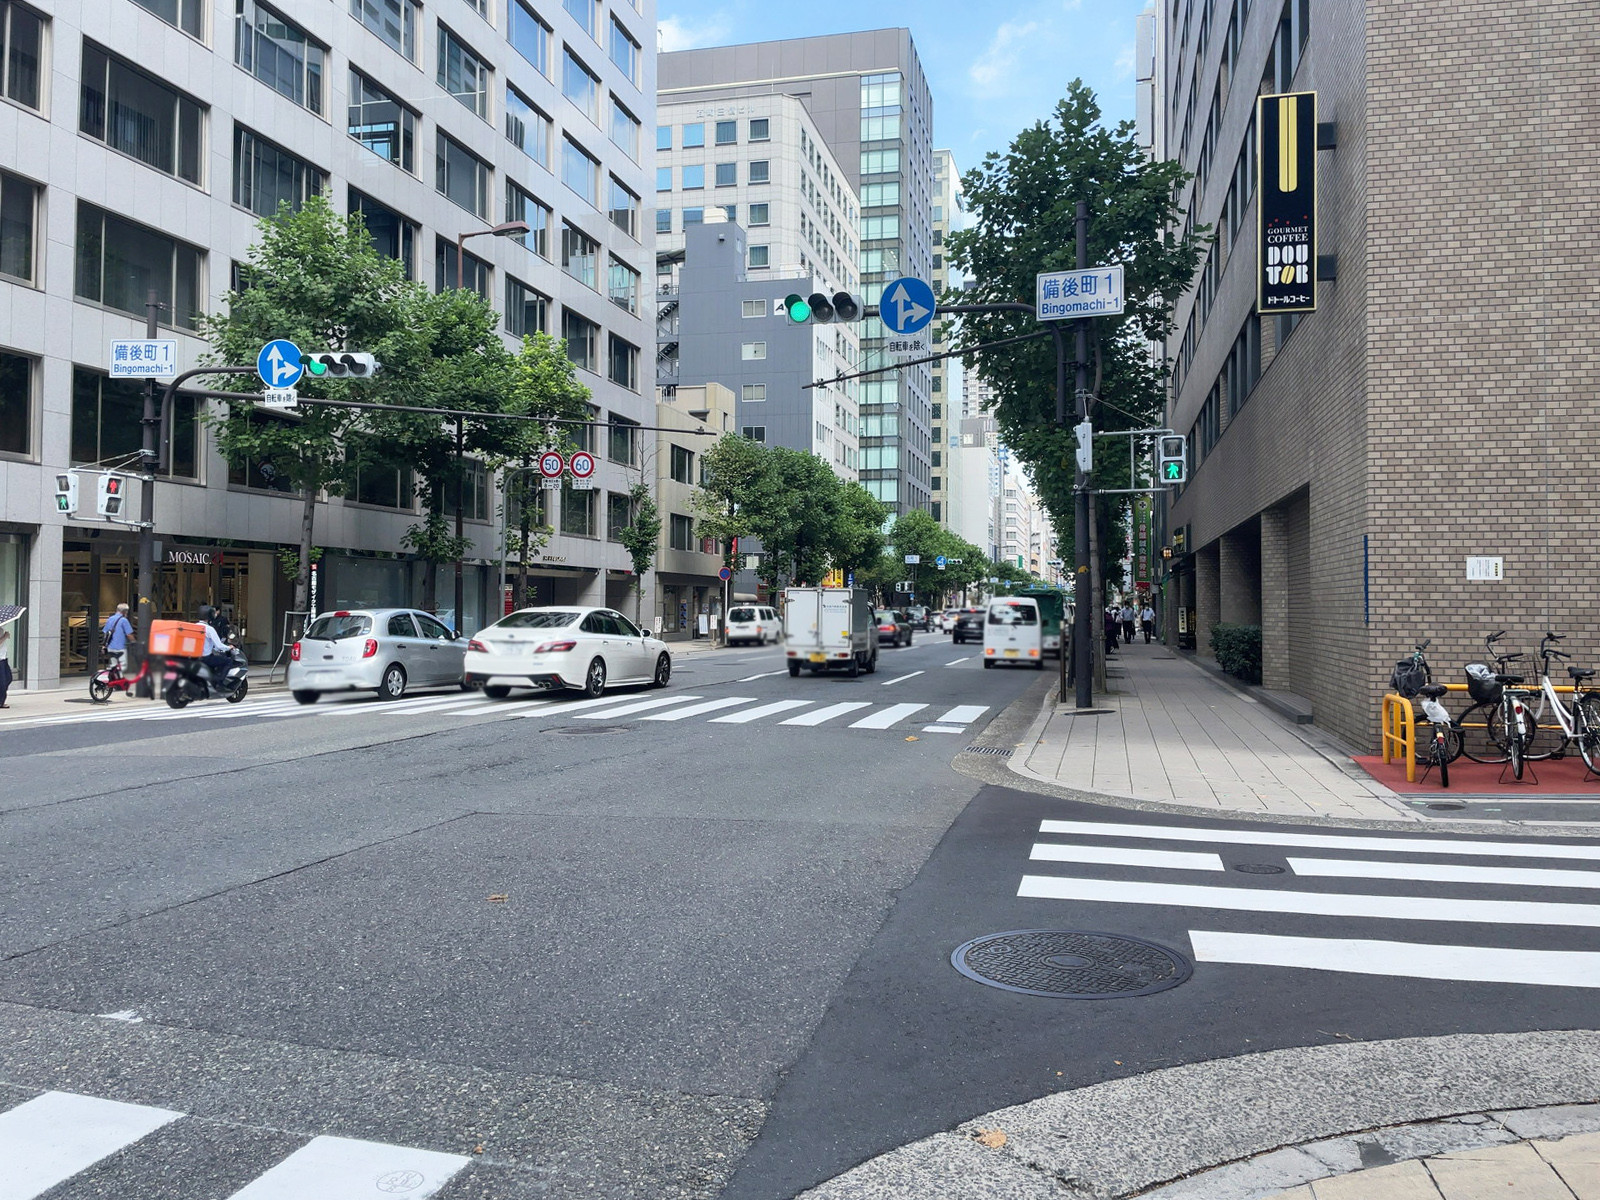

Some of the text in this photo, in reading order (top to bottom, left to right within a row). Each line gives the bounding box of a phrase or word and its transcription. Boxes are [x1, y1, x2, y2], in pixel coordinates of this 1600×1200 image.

[1267, 226, 1308, 235] GOURMET
[1267, 233, 1309, 244] COFFEE
[1267, 244, 1309, 266] DOU
[1265, 264, 1309, 285] TOR
[1267, 294, 1311, 305] ドトールコーヒー
[1041, 297, 1119, 315] Bingomachi-1
[889, 340, 925, 353] 自転車を除く
[113, 363, 173, 374] Bingomachi-1
[545, 459, 558, 471] 50
[575, 459, 590, 471] 60
